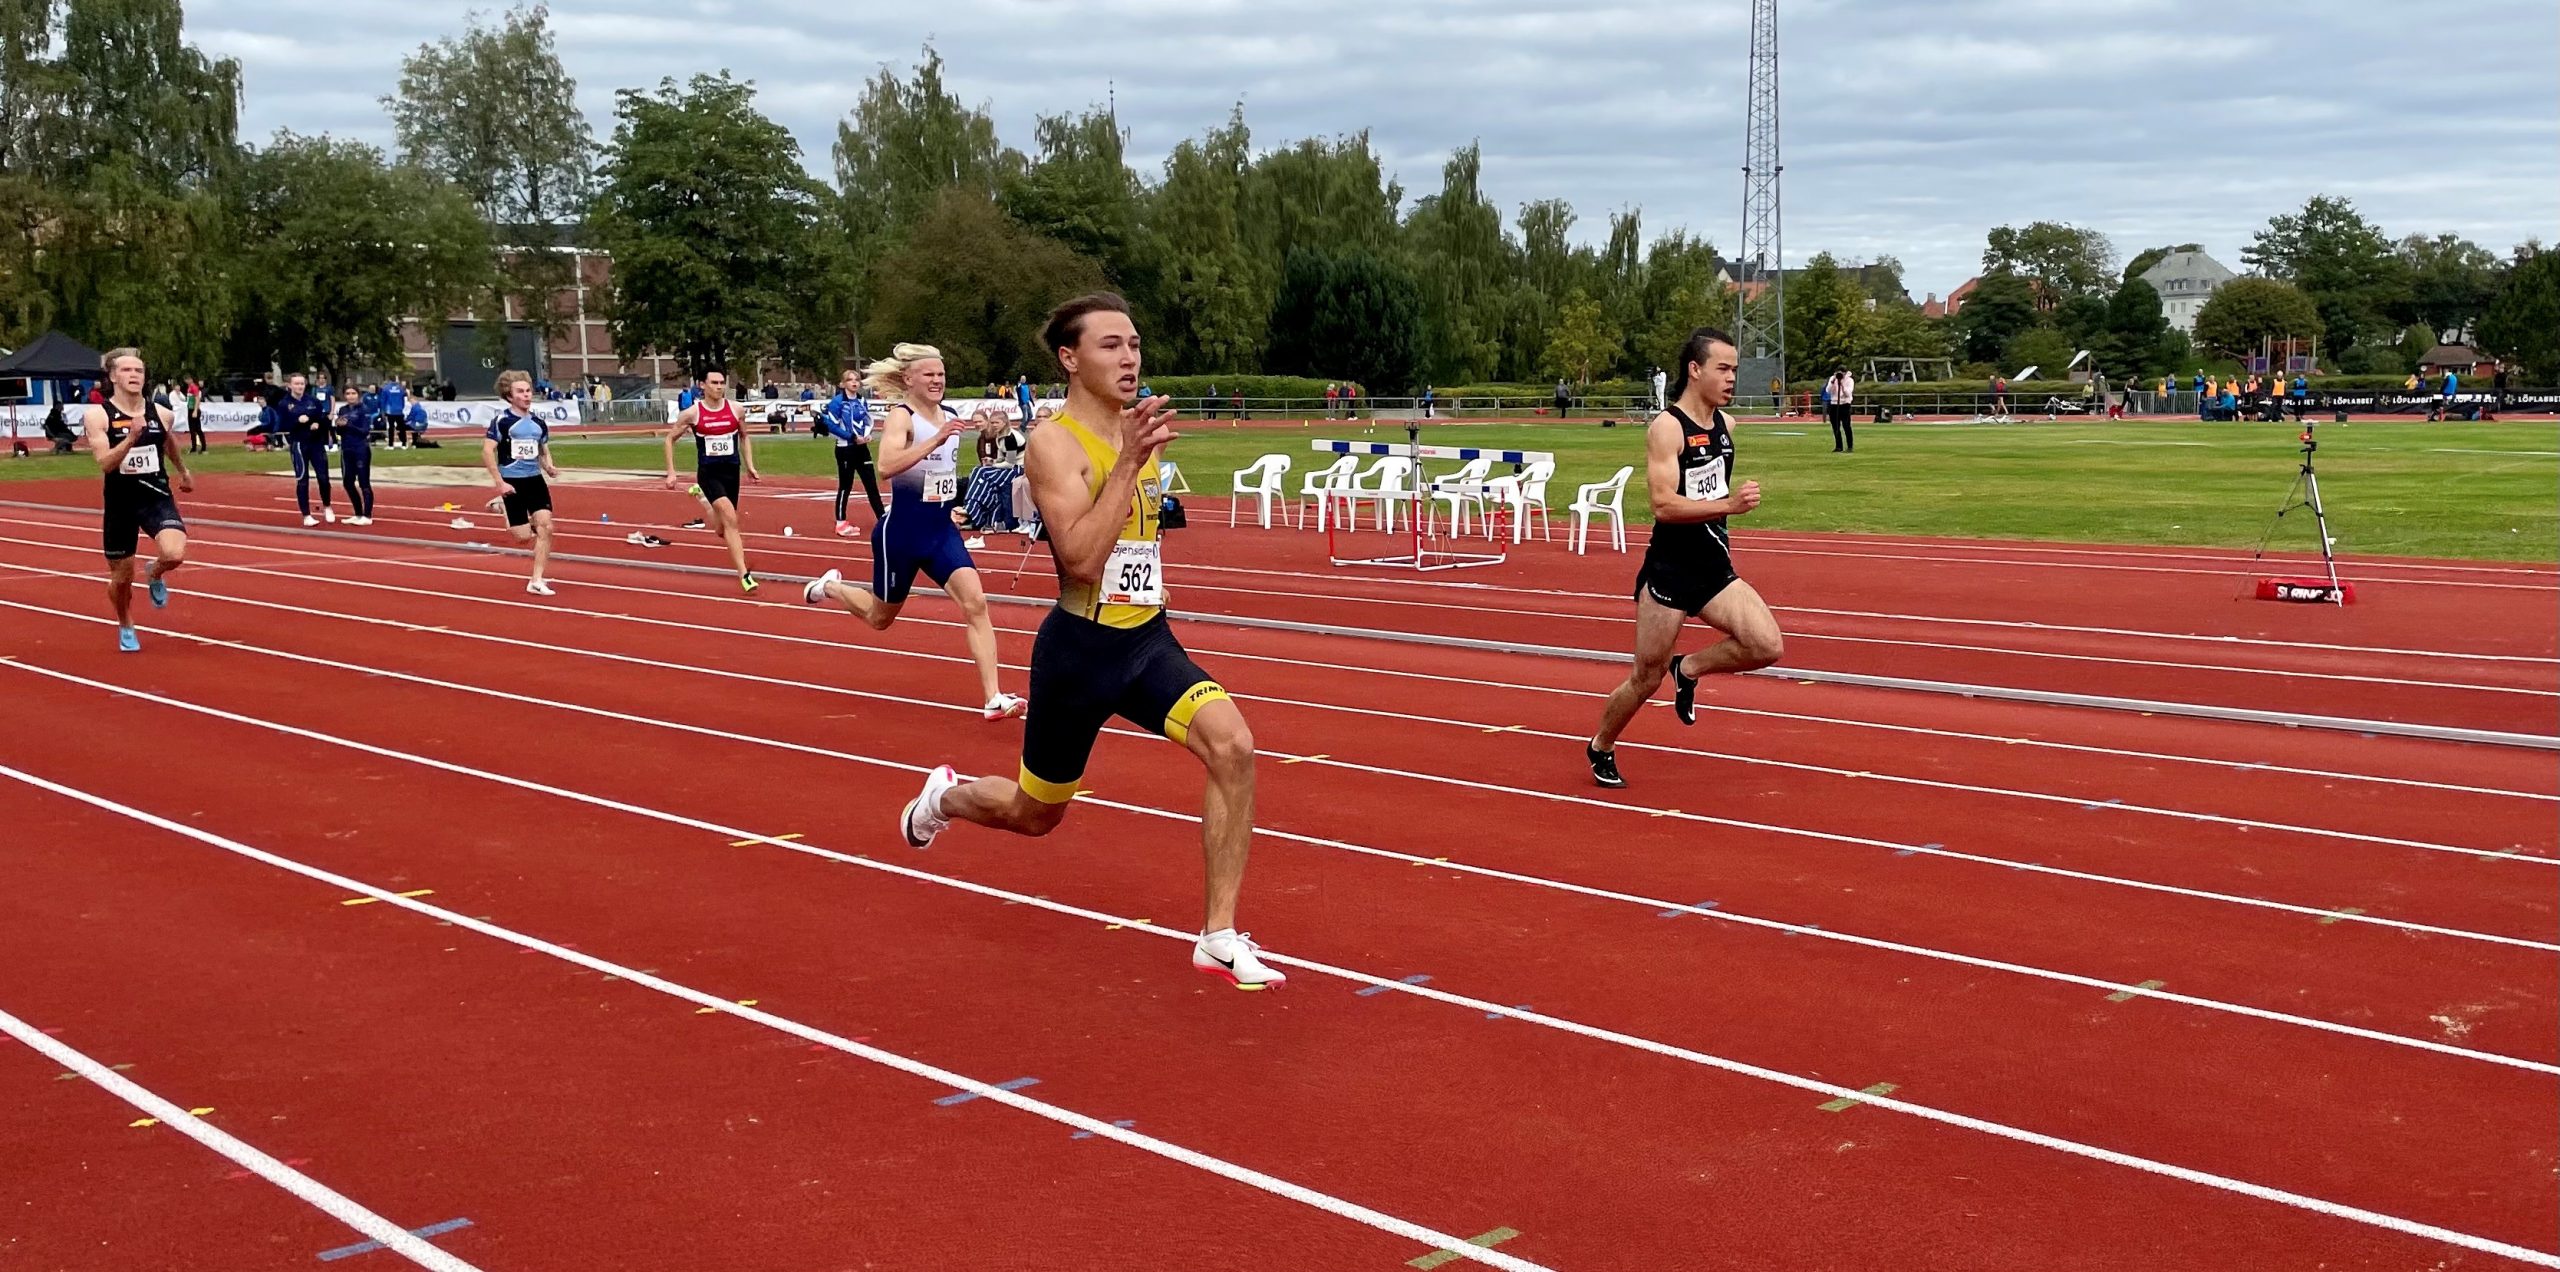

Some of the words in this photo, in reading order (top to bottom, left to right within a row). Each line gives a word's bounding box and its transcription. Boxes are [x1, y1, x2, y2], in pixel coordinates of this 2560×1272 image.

[2333, 396, 2374, 405] LÖPLABBET
[0, 413, 46, 428] jensidig
[518, 446, 534, 456] 264
[711, 442, 729, 452] 636
[128, 456, 150, 468] 491
[935, 478, 954, 495] 182
[1697, 473, 1718, 496] 480
[1119, 563, 1154, 592] 562
